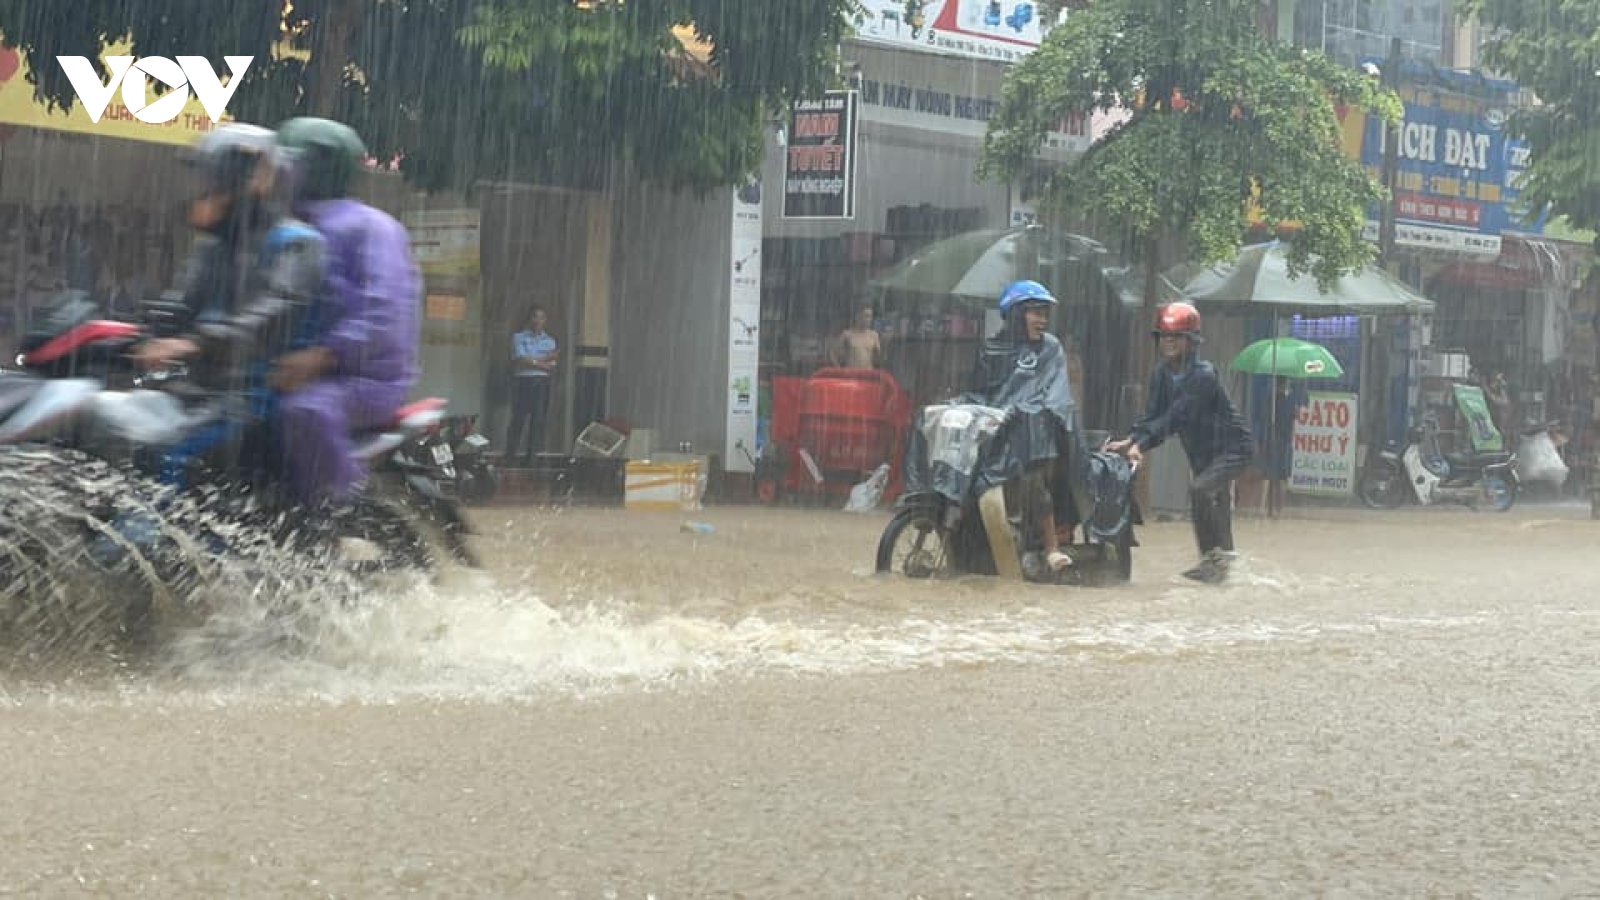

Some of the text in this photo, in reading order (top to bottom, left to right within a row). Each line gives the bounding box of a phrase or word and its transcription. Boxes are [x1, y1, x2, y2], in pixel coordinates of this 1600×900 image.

[1445, 127, 1491, 178] ĐẠT
[1294, 400, 1350, 428] GATO
[1294, 434, 1334, 453] NHƯ
